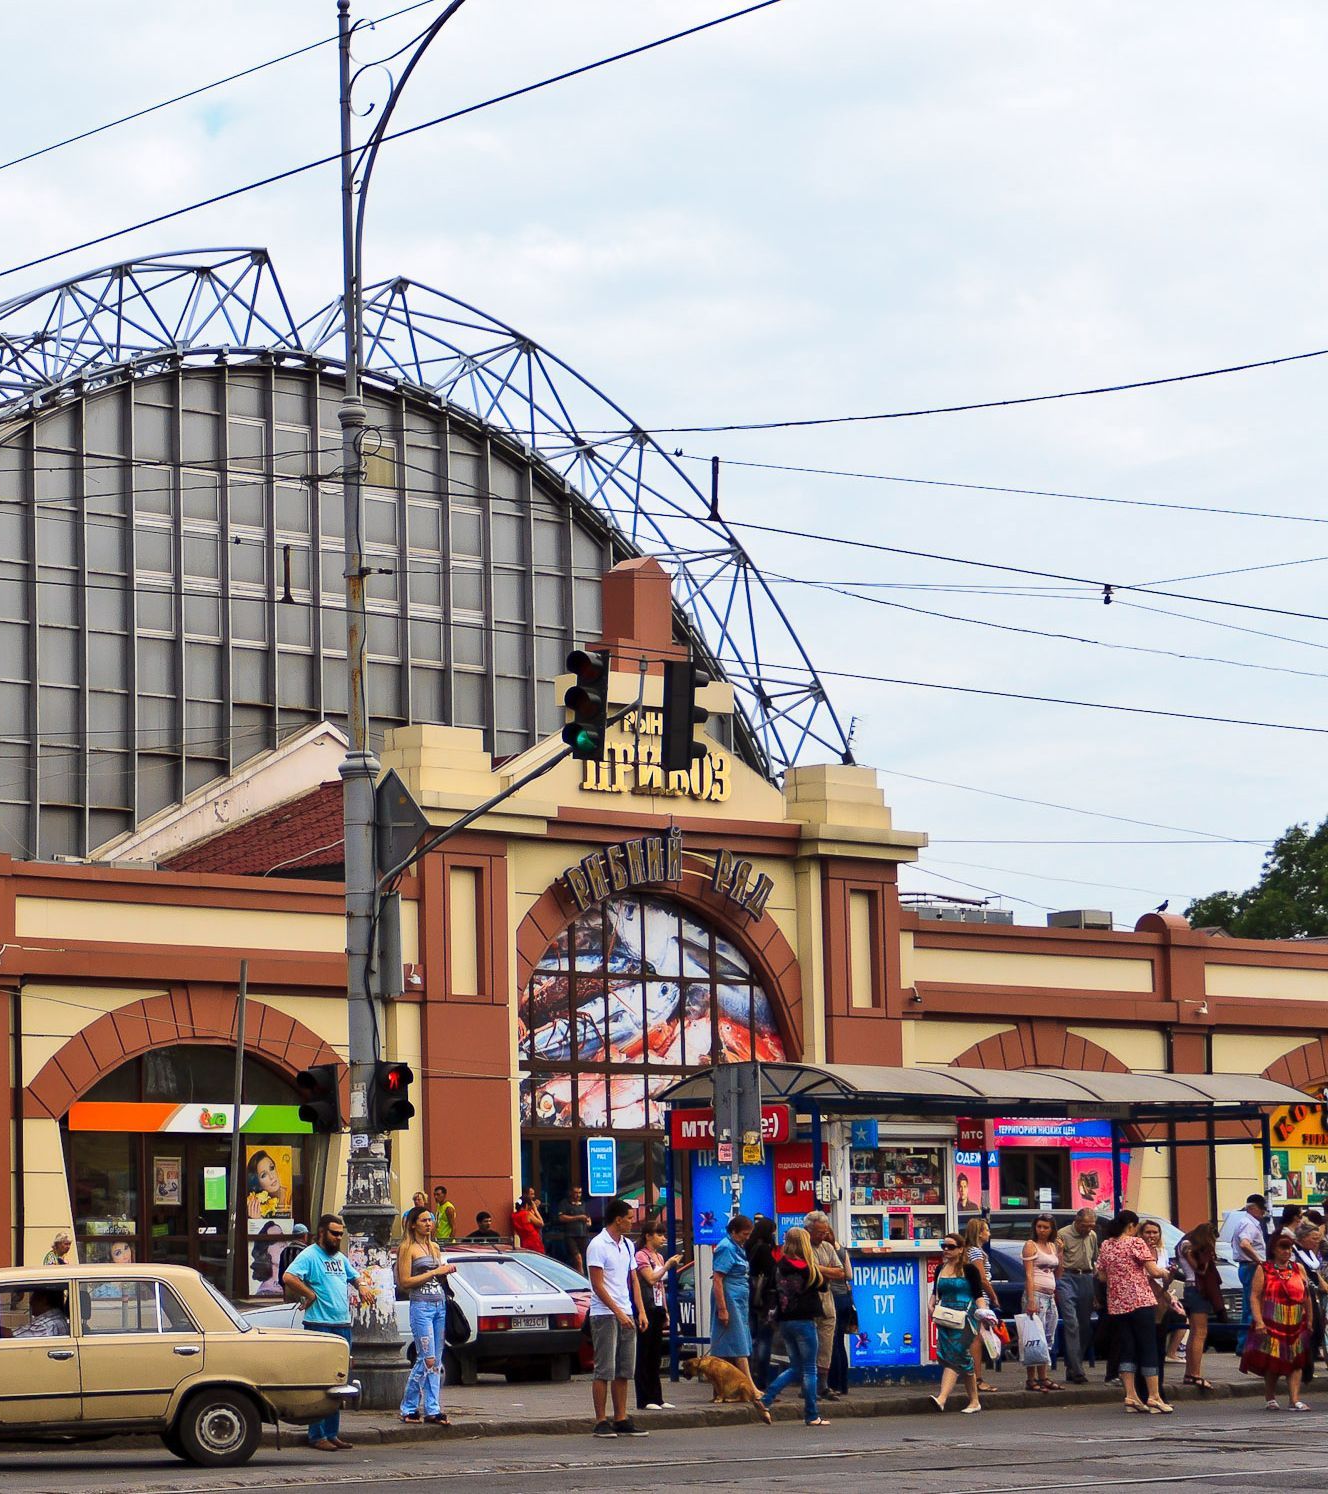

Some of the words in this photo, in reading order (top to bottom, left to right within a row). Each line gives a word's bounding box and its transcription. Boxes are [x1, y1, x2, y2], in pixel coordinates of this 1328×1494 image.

[623, 710, 663, 735] РЫН
[714, 849, 774, 921] РЯД
[199, 1107, 227, 1129] eva
[961, 1130, 984, 1139] МТС
[998, 1125, 1037, 1135] ТЕРРИТОРИЯ
[1037, 1125, 1062, 1135] НИЗКИХ
[1062, 1126, 1076, 1137] ЦЕН
[955, 1151, 997, 1165] ОДЕЖА
[799, 1180, 814, 1191] МТ
[781, 1216, 804, 1226] ПРИДБ
[853, 1263, 914, 1288] ПРИДБАЙ
[873, 1294, 896, 1315] ТУТ
